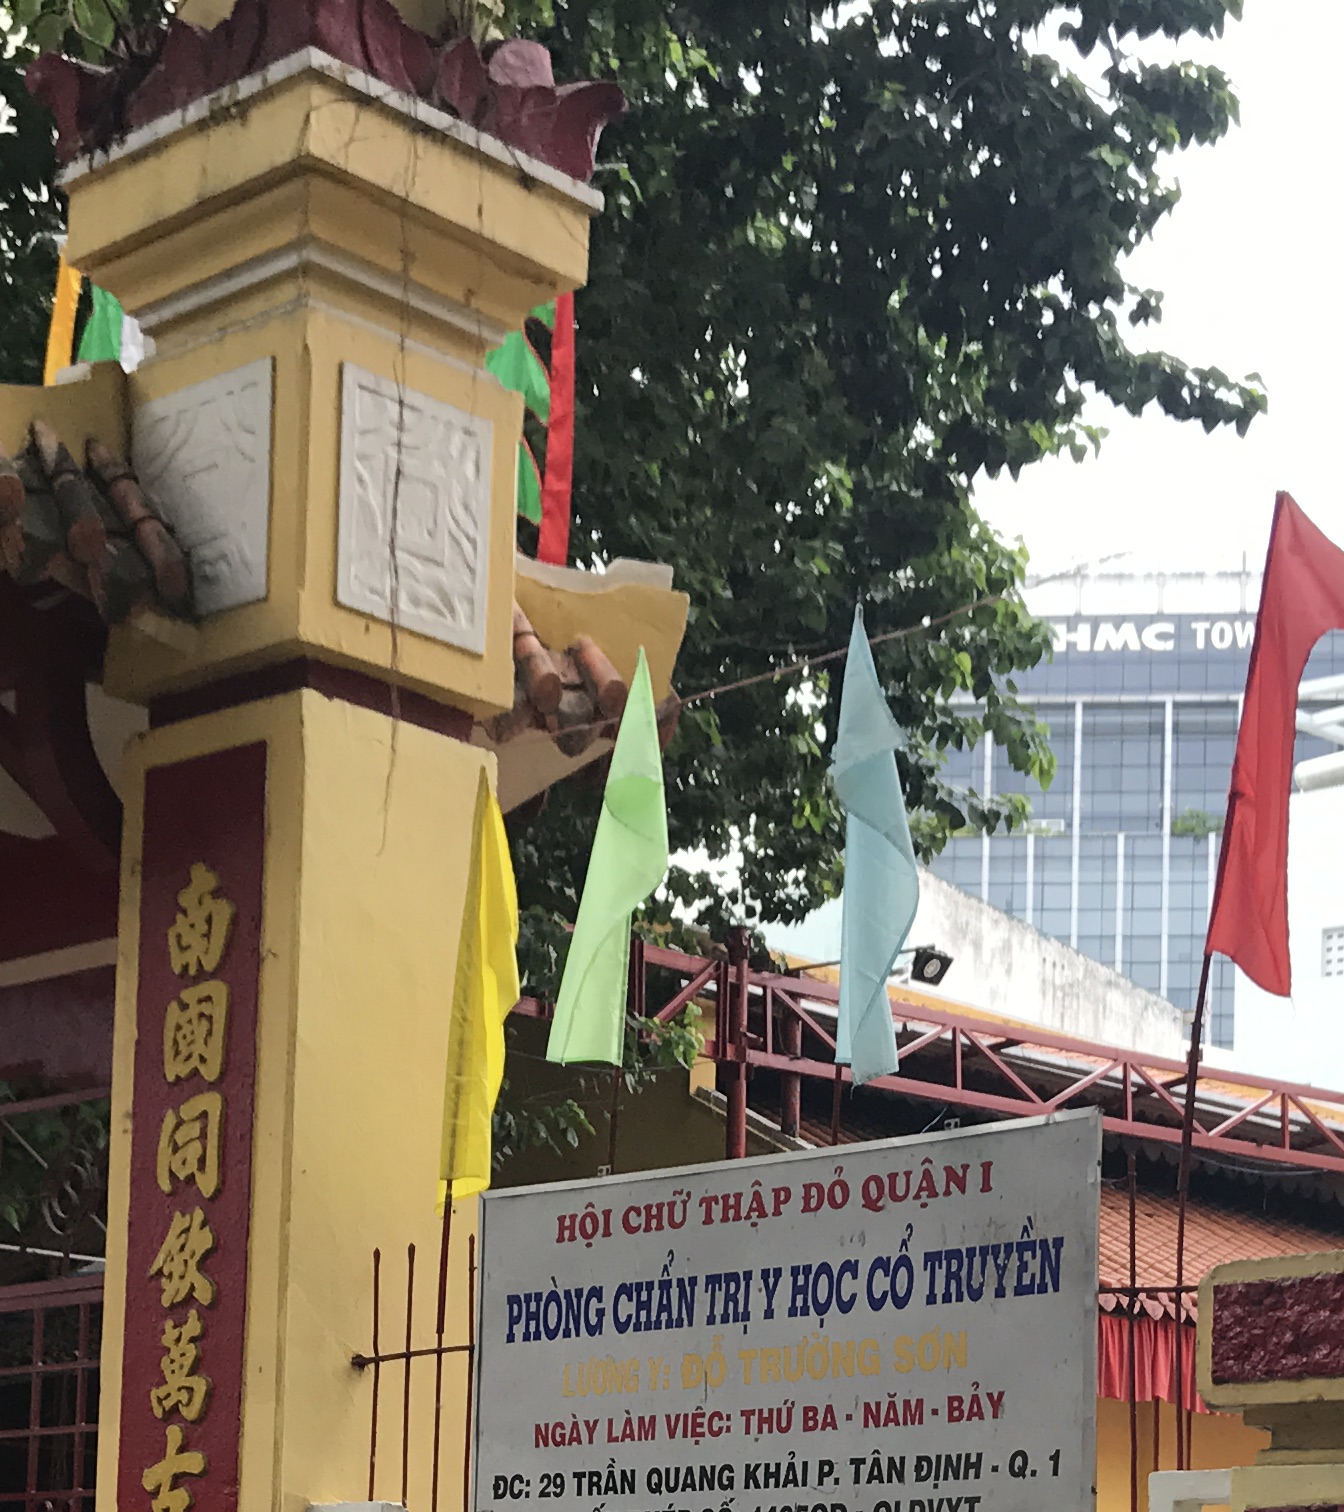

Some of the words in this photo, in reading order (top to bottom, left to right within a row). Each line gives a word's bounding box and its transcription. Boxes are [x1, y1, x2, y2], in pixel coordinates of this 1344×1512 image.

[1052, 620, 1175, 652] HMC
[1191, 619, 1256, 651] TOW
[556, 1202, 613, 1248] HỘI
[622, 1189, 692, 1235] CHỮ
[699, 1179, 791, 1228] THẬP
[801, 1165, 850, 1213] ĐỎ
[861, 1157, 971, 1212] QUẬN
[506, 1275, 606, 1344] PHÒNG
[612, 1249, 698, 1335] CHẨN
[705, 1270, 754, 1335] TRỊ
[761, 1267, 783, 1320] Y
[788, 1258, 860, 1329] HỌC
[866, 1222, 915, 1312] CỔ
[923, 1215, 1065, 1306] TRUYỀN
[680, 1334, 727, 1390] ĐỖ
[738, 1332, 881, 1386] TRƯỜNG
[893, 1325, 968, 1374] SƠN
[534, 1412, 600, 1448] NGÀY
[607, 1409, 657, 1444] LÀM
[664, 1405, 732, 1446] VIỆC:
[740, 1398, 796, 1436] THỨ
[802, 1403, 838, 1432] BA
[862, 1392, 924, 1429] NĂM
[947, 1381, 1005, 1424] BẢY
[492, 1473, 531, 1500] ĐC:
[537, 1472, 566, 1499] 29
[572, 1457, 637, 1497] TRẦN
[646, 1463, 735, 1497] QUANG
[743, 1451, 809, 1490] KHẢI
[817, 1459, 840, 1487] P.
[849, 1449, 907, 1486] TÂN
[914, 1451, 984, 1490] ĐỊNH
[1048, 1449, 1062, 1478] 1
